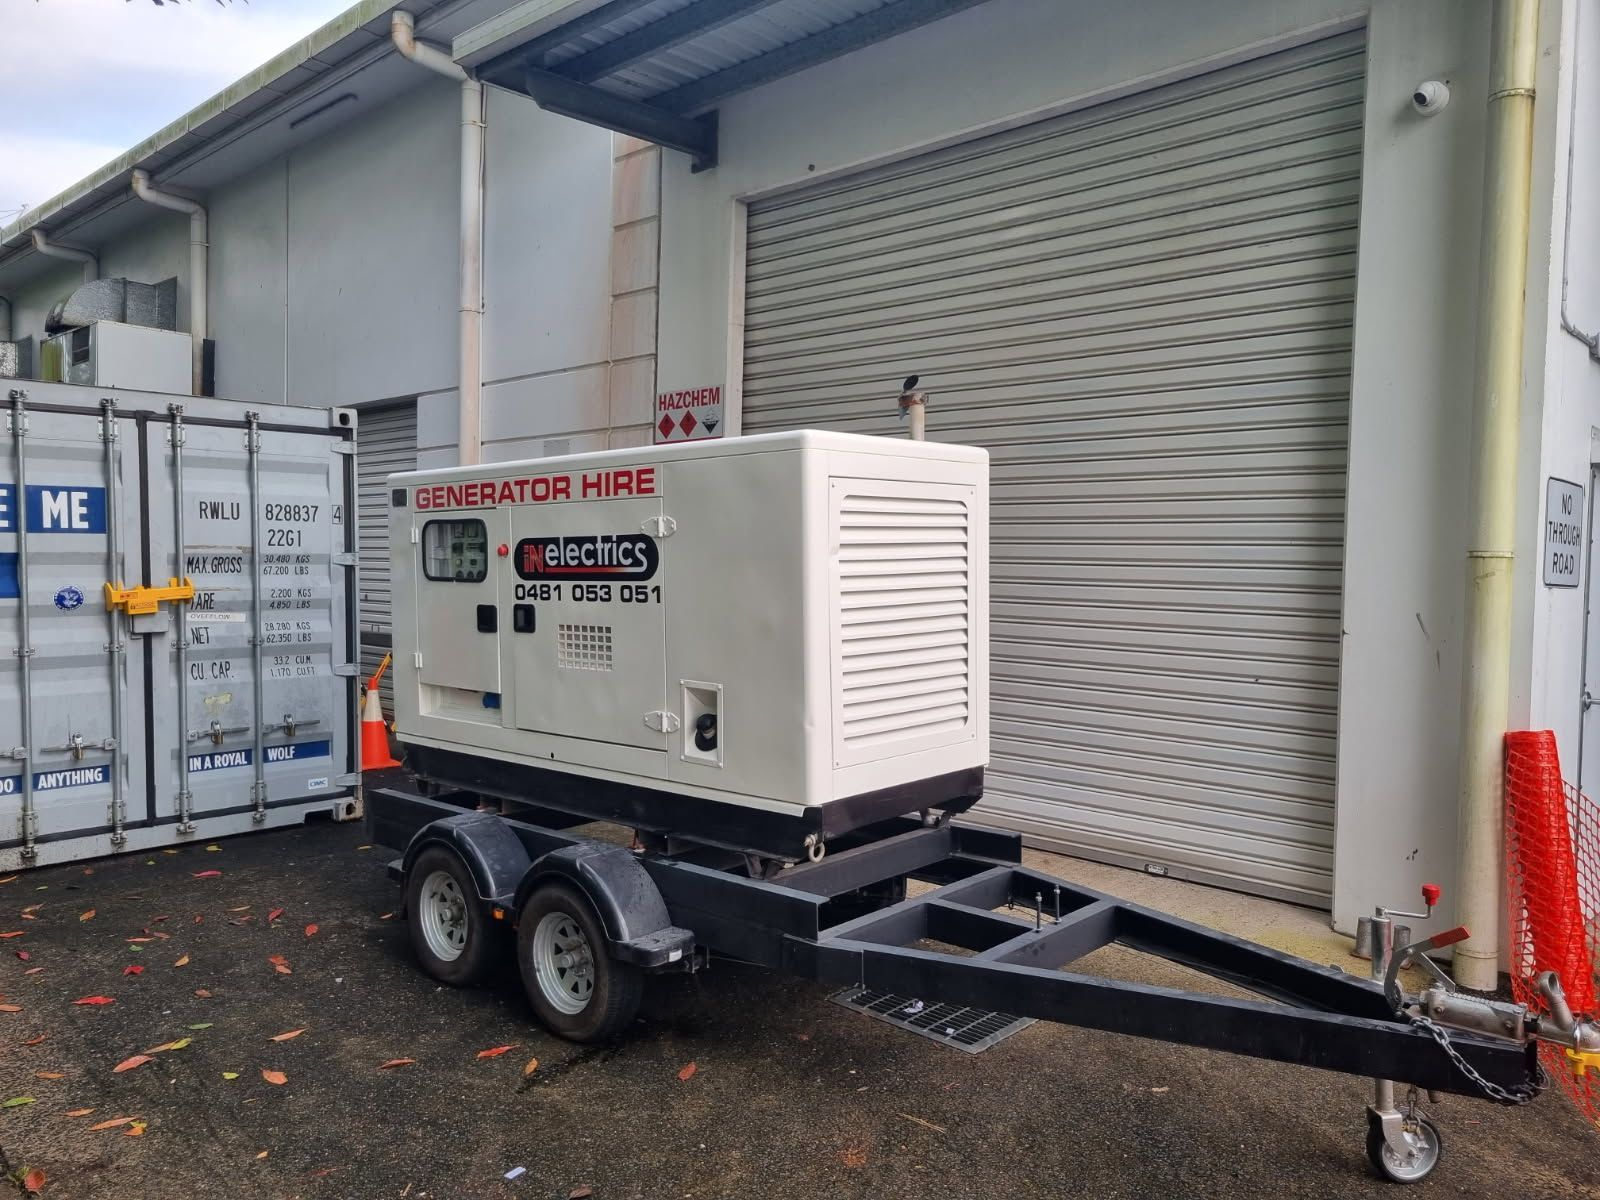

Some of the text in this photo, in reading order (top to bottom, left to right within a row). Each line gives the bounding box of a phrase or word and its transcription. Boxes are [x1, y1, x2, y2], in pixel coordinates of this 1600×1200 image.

[658, 386, 720, 411] HAZCHEM
[415, 468, 656, 509] GENERATOR HIRE
[41, 490, 89, 529] ME
[199, 501, 342, 523] RWLU 828837 4
[1561, 493, 1572, 516] NO
[267, 528, 302, 548] 22G1
[1548, 521, 1581, 547] THROUGH
[264, 554, 291, 564] 30.480
[295, 554, 311, 564] KGS
[1552, 552, 1575, 576] ROAD
[263, 566, 309, 576] 67.200 LBS
[270, 589, 292, 598] 2.200
[297, 588, 312, 598] KGS
[514, 584, 662, 604] 0481 053 051
[269, 600, 311, 610] 4.850 LBS
[191, 621, 311, 645] NET 28.280 KGS
[266, 633, 312, 643] 62.350 LBS
[211, 661, 234, 679] CAP.
[37, 767, 103, 790] ANYTHING
[189, 756, 202, 772] IN
[203, 756, 212, 770] A
[214, 751, 248, 768] ROYAL
[267, 745, 295, 761] WOLF
